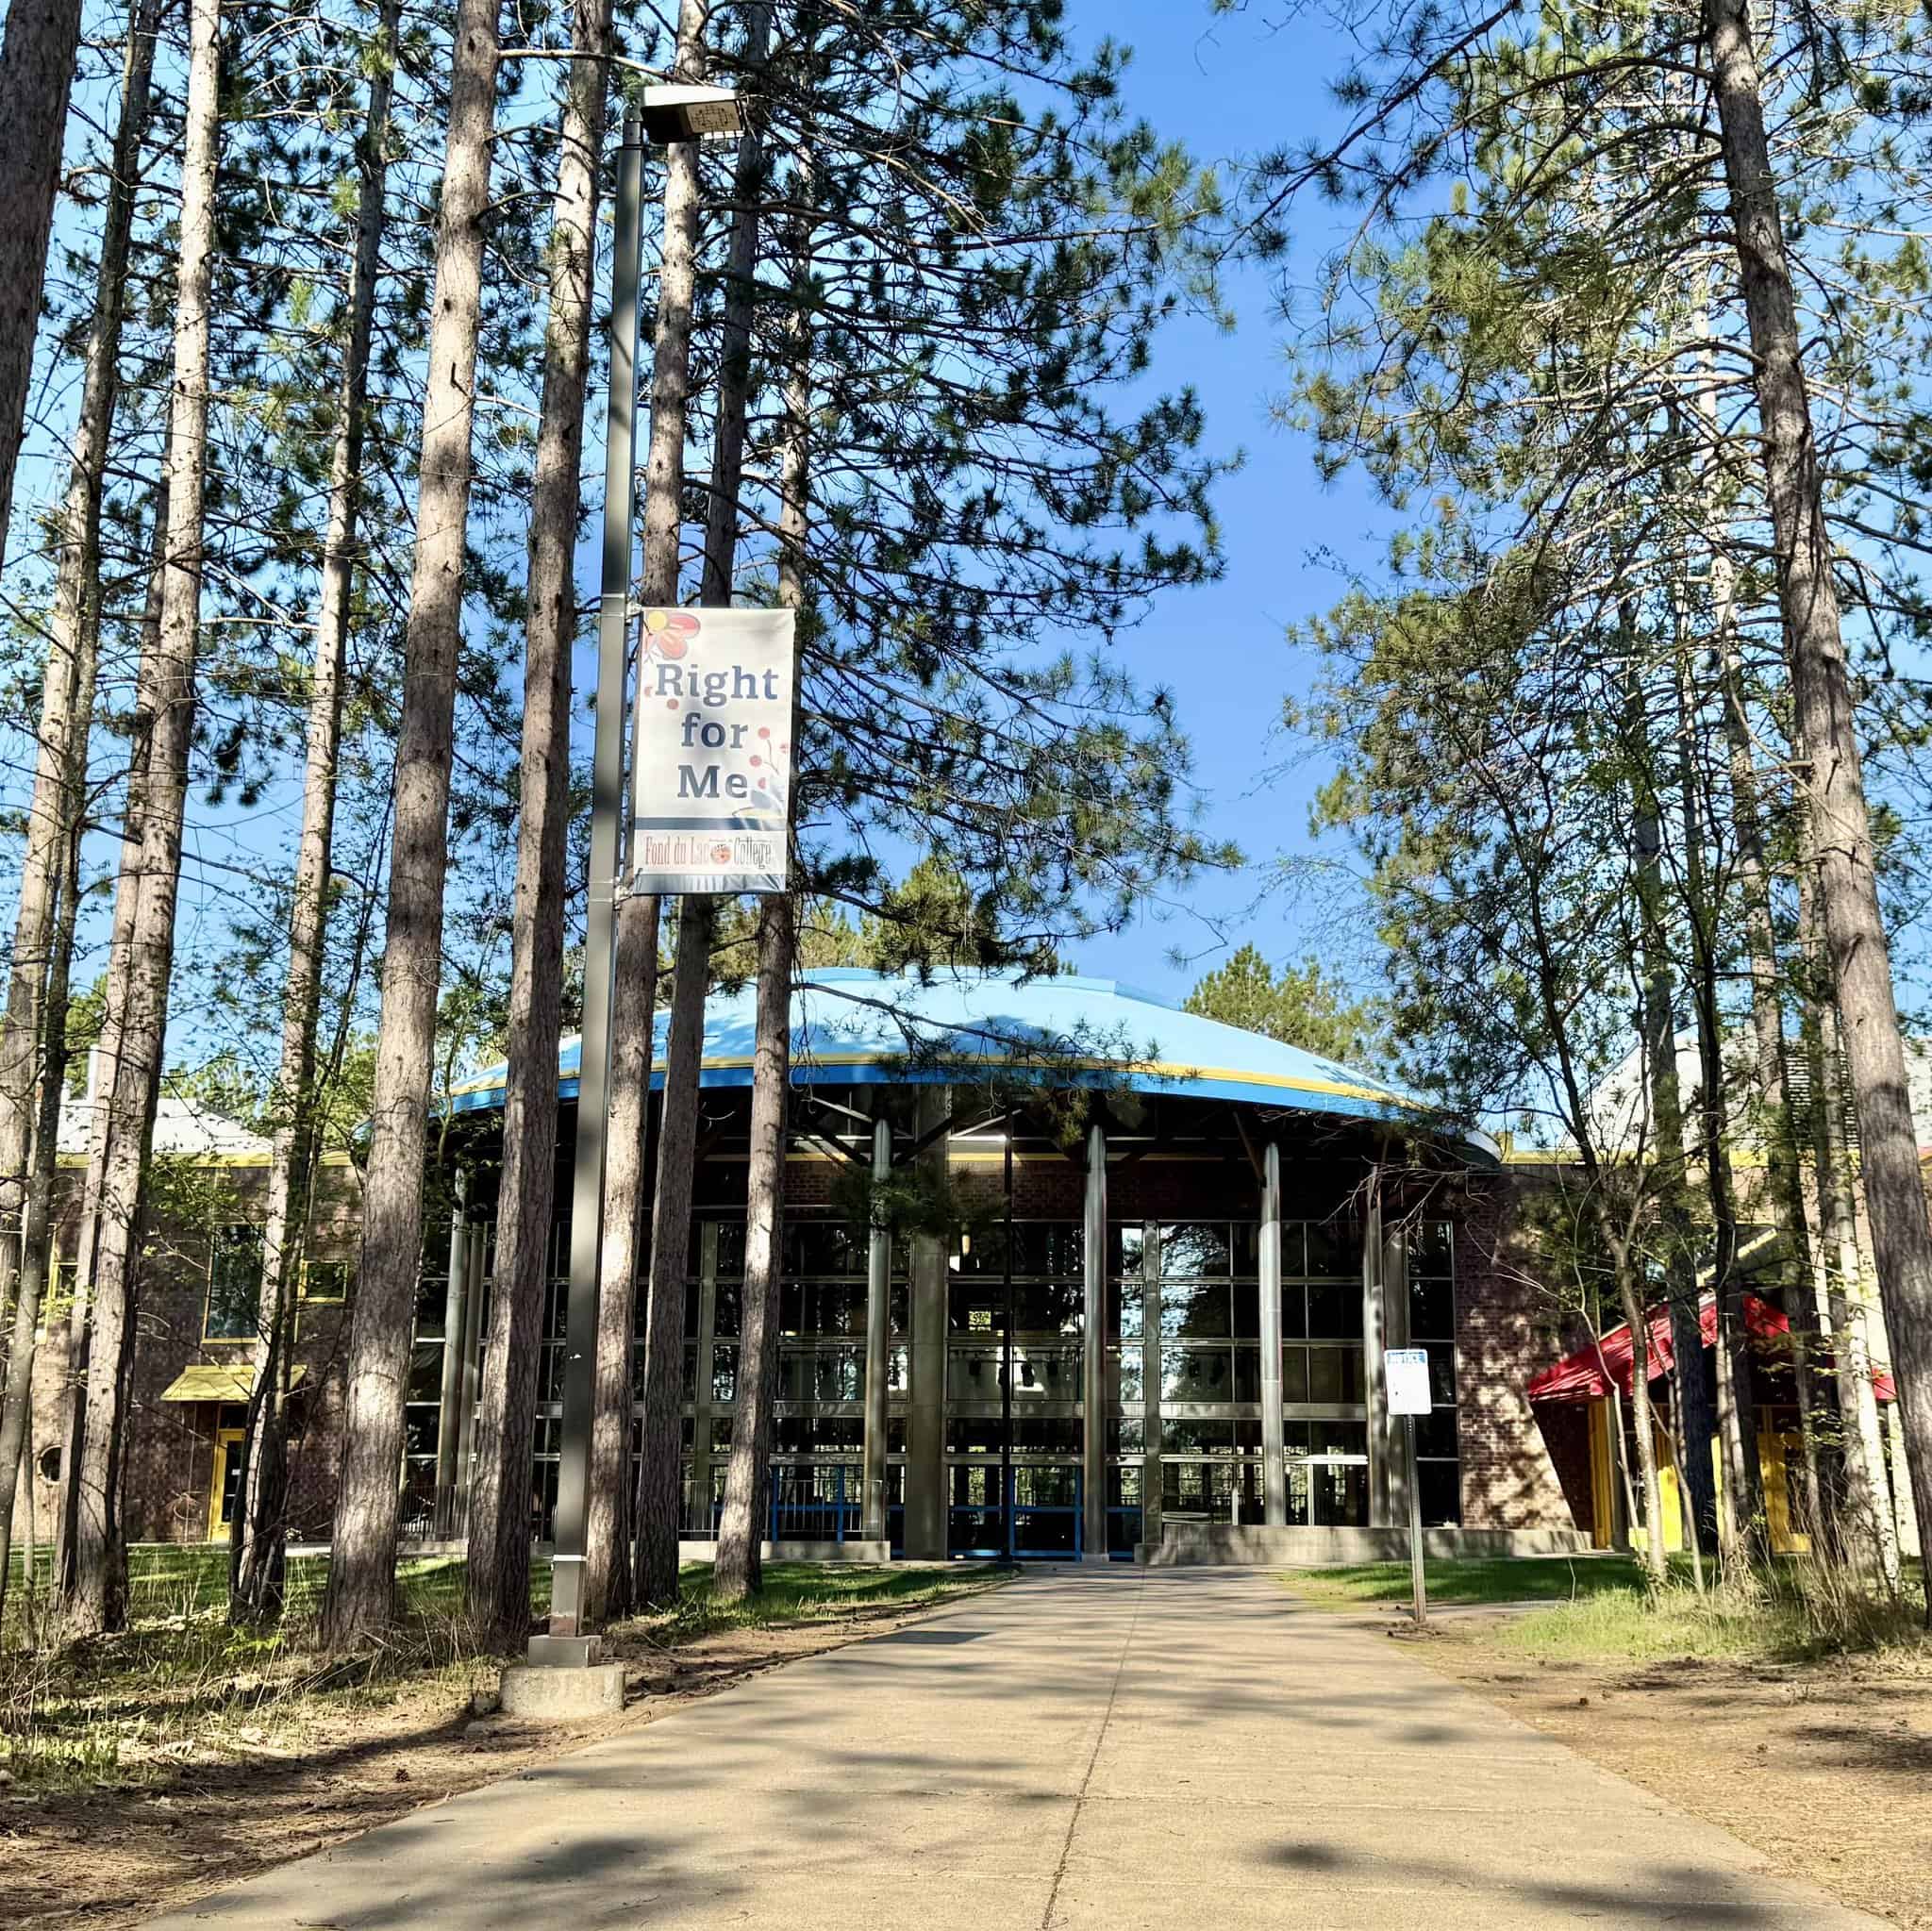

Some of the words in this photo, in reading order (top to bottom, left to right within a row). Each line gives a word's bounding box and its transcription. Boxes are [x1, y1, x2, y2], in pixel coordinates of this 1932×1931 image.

[655, 663, 779, 707] Right
[681, 712, 748, 748] for
[677, 765, 748, 798] Me
[645, 836, 671, 865] Fond
[674, 836, 687, 865] du
[734, 837, 772, 869] College
